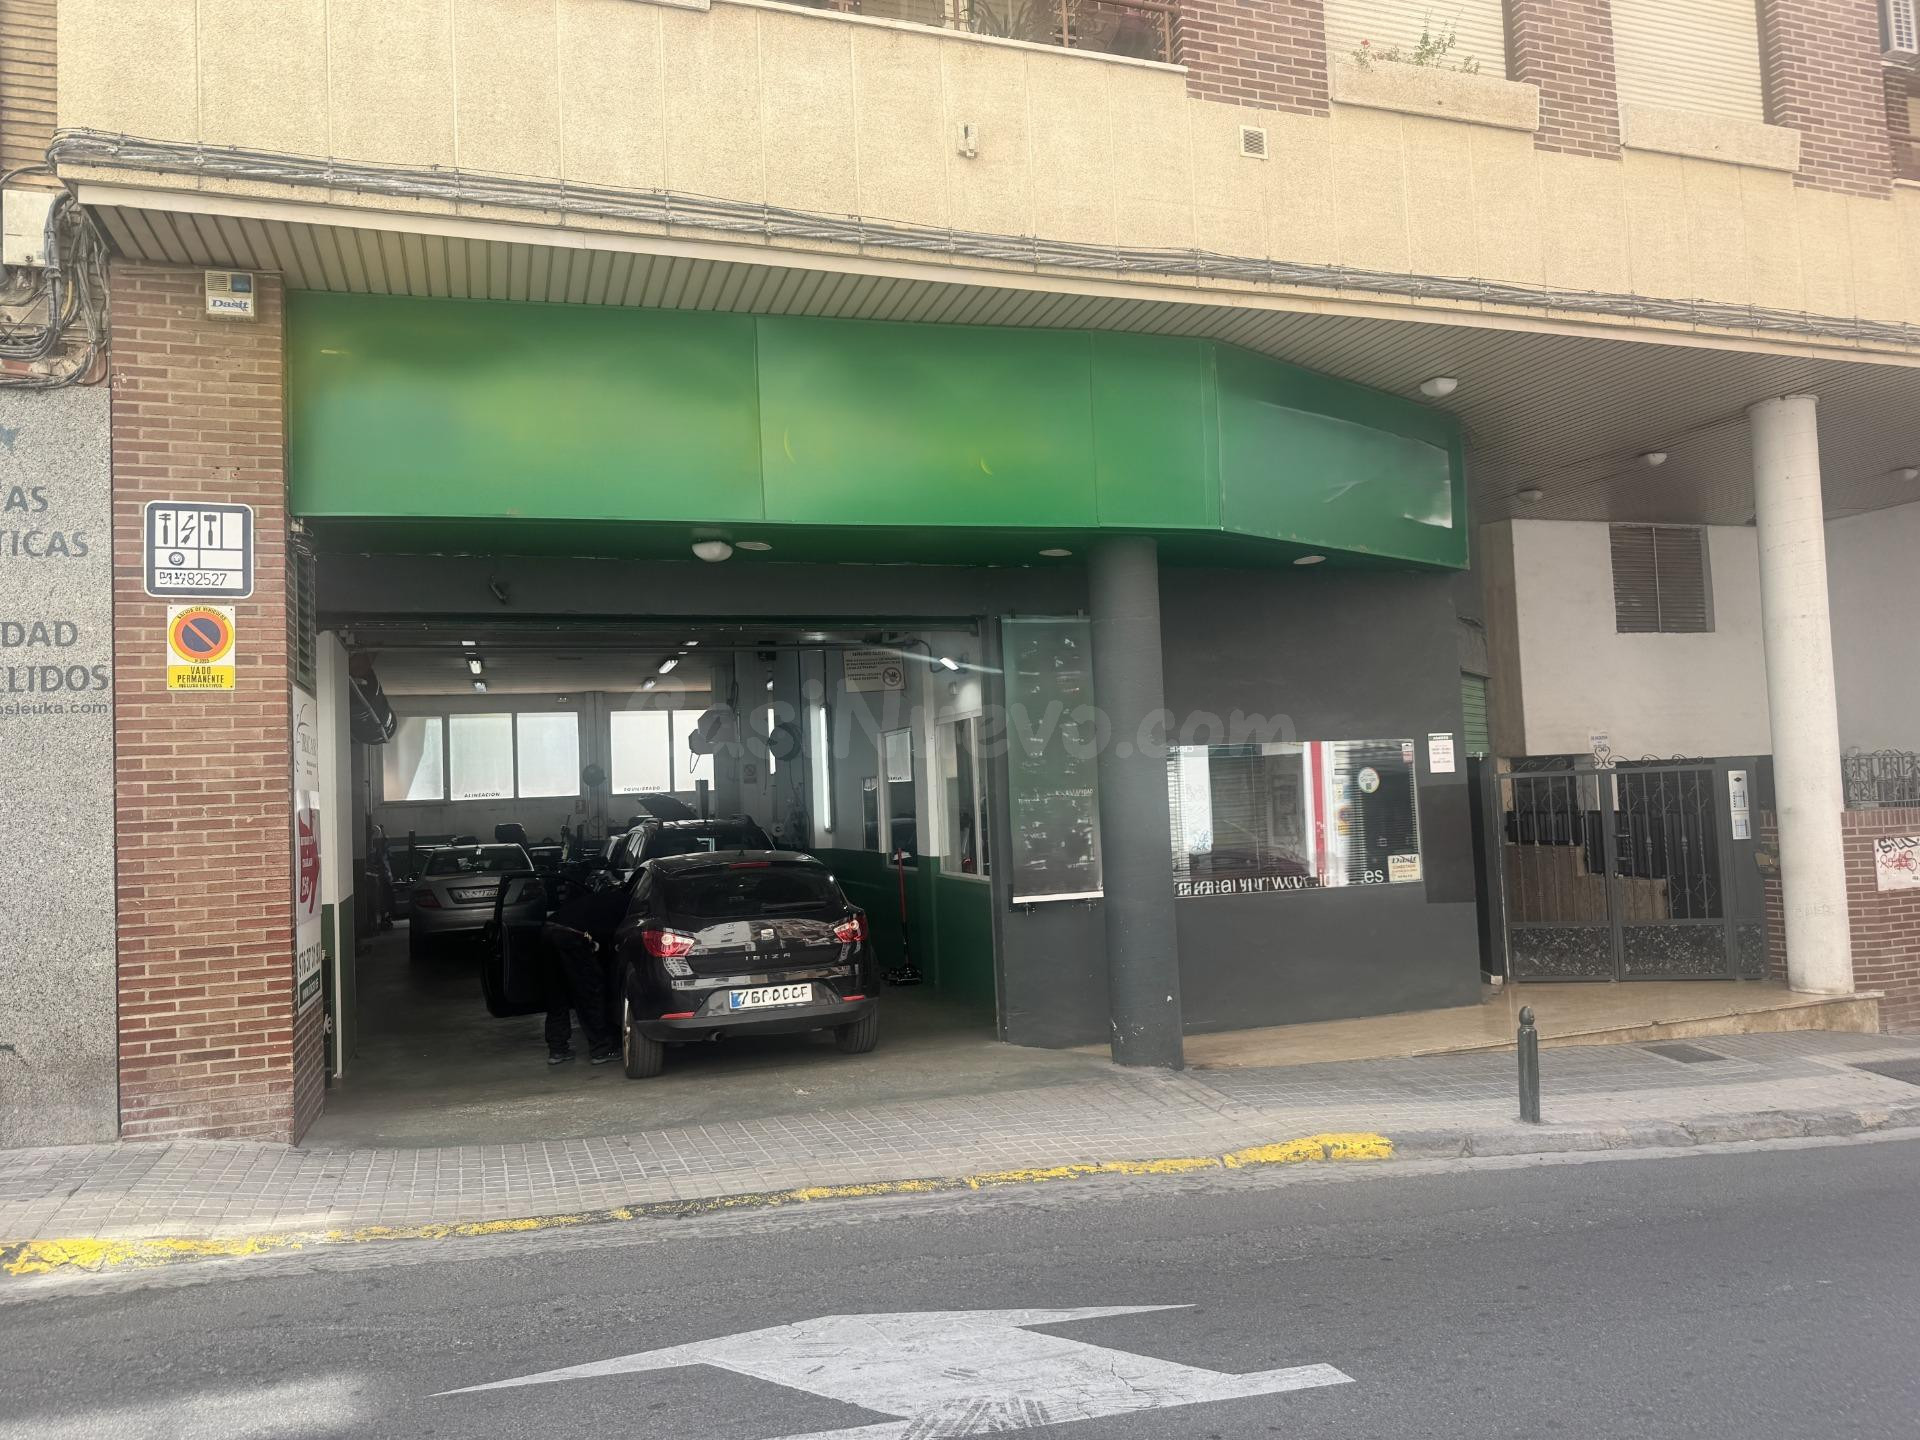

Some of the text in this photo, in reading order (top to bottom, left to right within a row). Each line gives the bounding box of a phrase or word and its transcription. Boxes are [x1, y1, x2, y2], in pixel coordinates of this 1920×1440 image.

[190, 666, 212, 674] VADO
[0, 664, 109, 693] LIDOS
[177, 675, 225, 684] PERMANENTE
[745, 952, 791, 960] IBIZA
